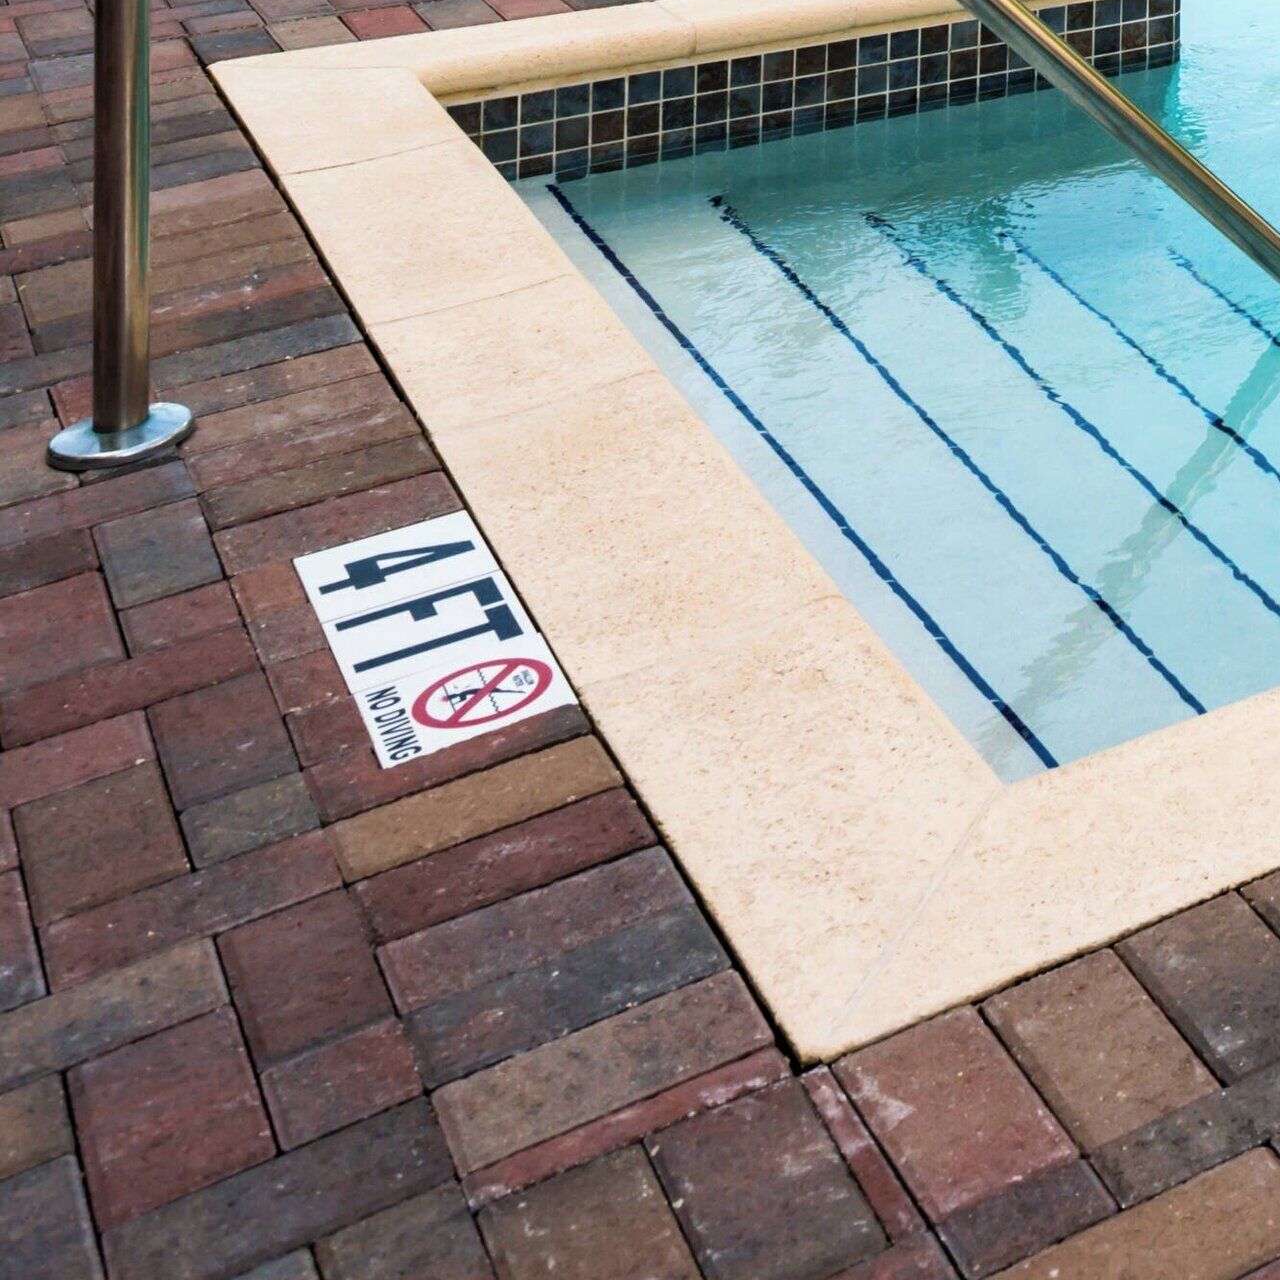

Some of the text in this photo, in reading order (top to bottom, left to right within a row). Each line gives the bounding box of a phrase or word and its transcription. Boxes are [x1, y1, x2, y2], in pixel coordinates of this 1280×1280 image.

[318, 540, 524, 674] 4 FT
[365, 686, 423, 761] NO DIVING
